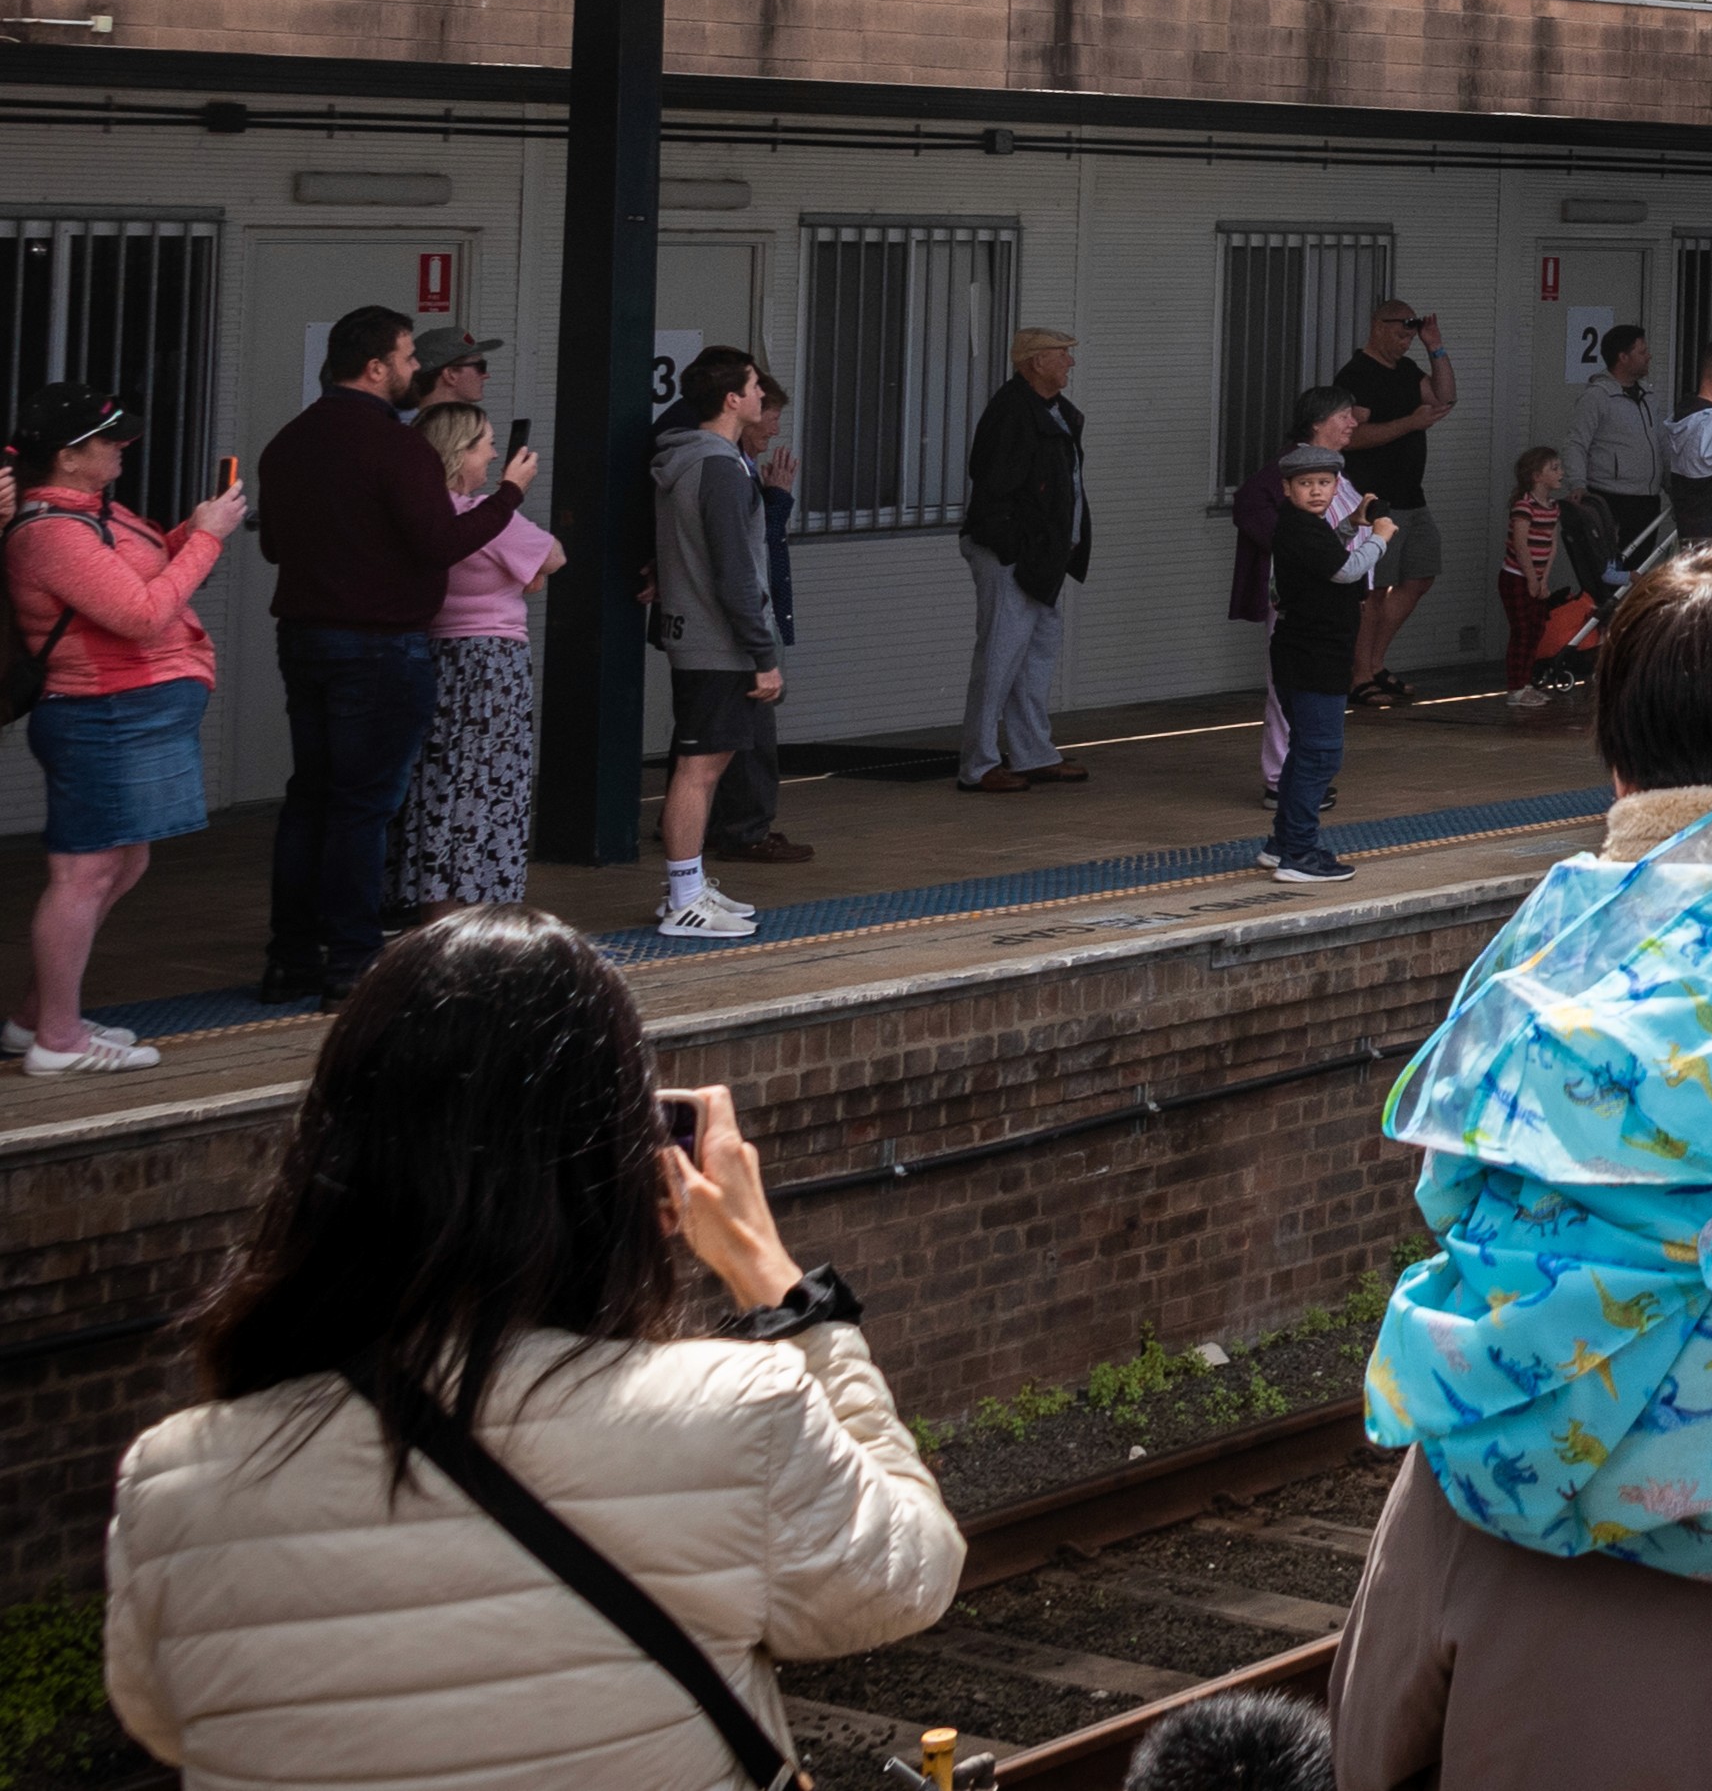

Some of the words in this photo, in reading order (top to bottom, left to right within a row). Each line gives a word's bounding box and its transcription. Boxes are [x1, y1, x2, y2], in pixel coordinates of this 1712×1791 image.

[1581, 326, 1598, 364] 2
[651, 356, 676, 404] 3
[1188, 890, 1315, 912] MIND
[992, 925, 1096, 947] GAP
